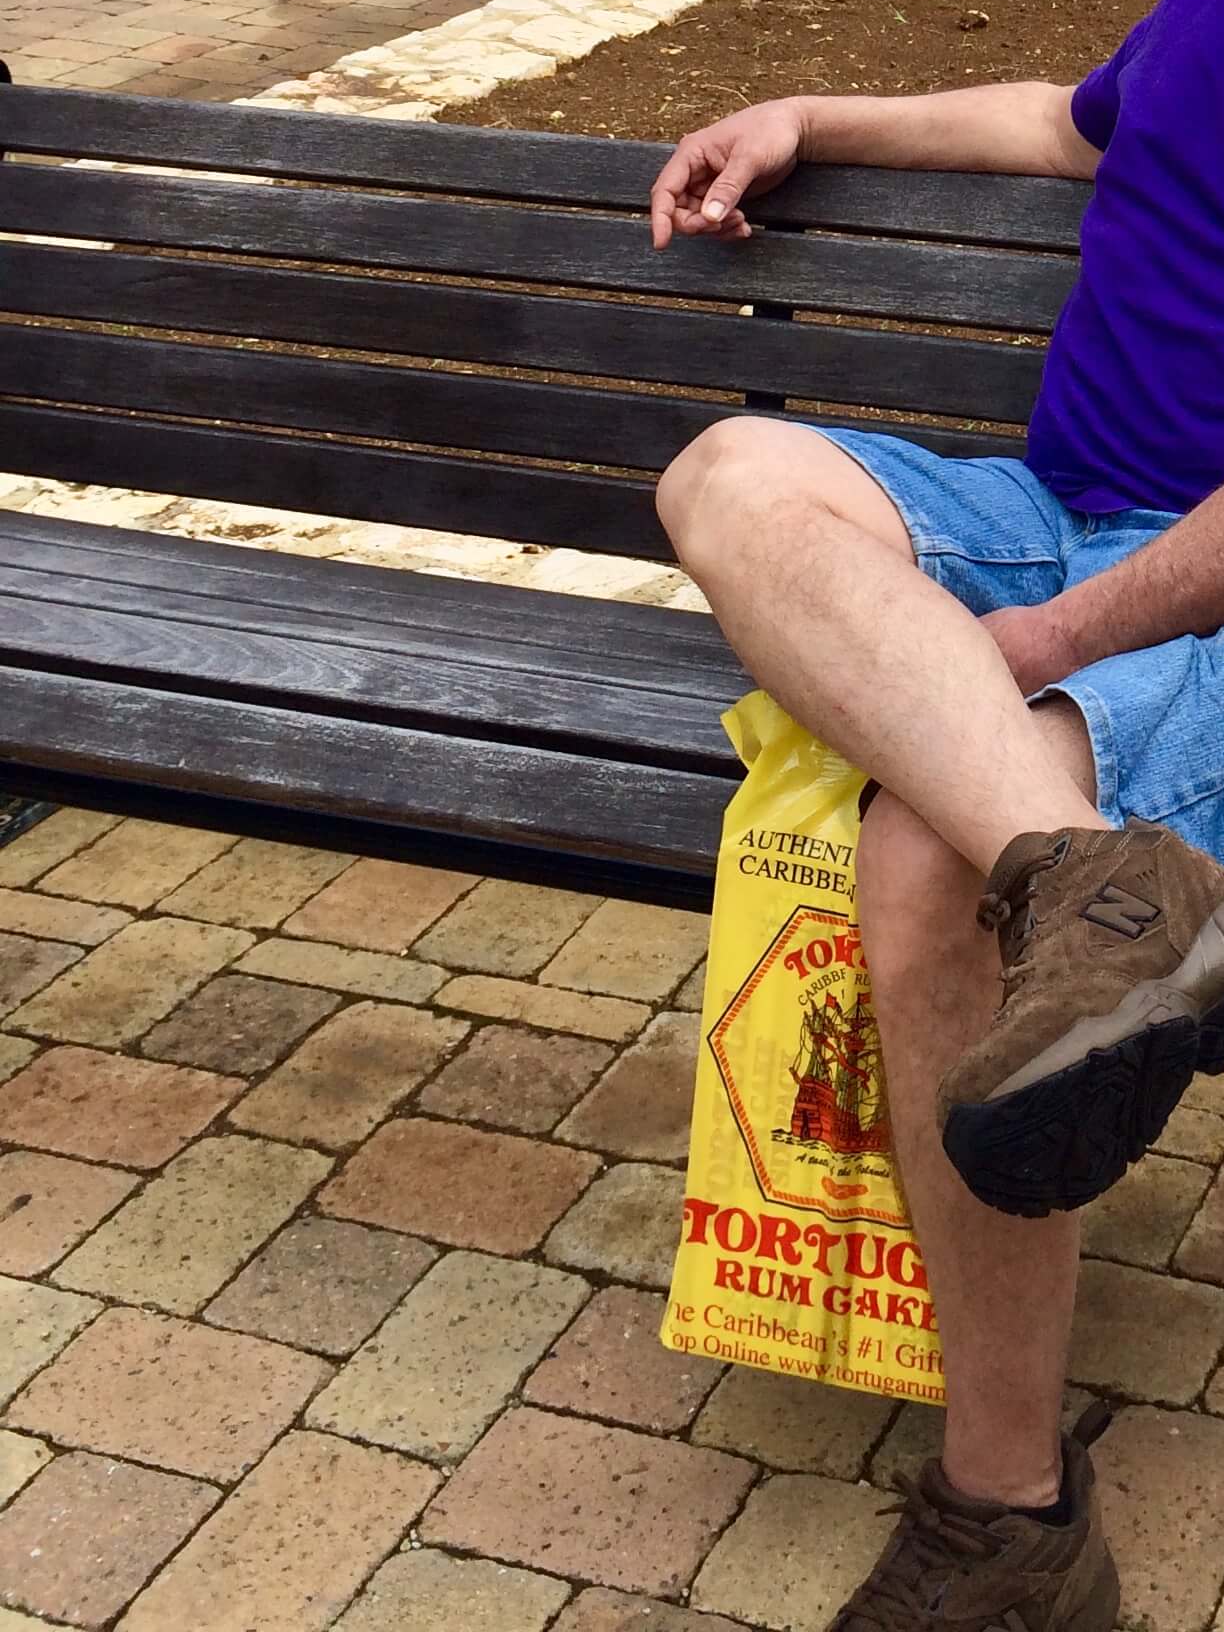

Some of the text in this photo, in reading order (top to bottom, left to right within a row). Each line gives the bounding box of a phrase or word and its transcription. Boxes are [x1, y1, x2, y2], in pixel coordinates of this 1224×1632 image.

[739, 829, 853, 867] AUTHENT
[739, 854, 856, 904] CARIBBE
[1079, 883, 1162, 940] N
[684, 1198, 928, 1290] TORTUG
[714, 1257, 815, 1307] RUM
[672, 1332, 946, 1402] op Online www.tortugarum
[857, 1336, 883, 1363] #1
